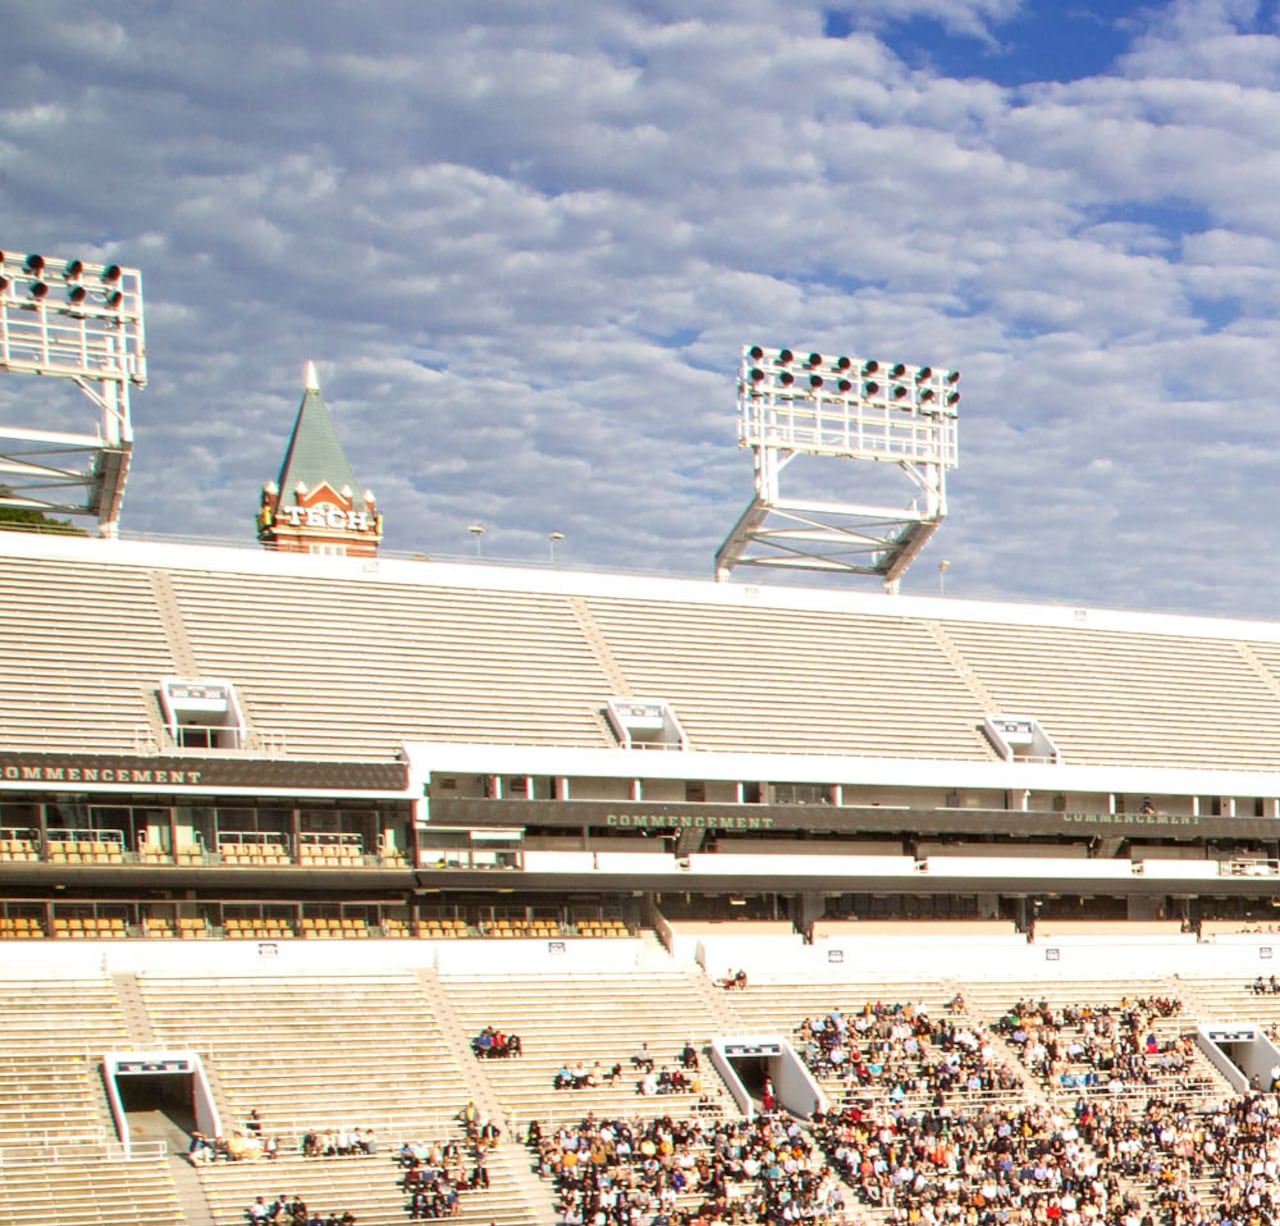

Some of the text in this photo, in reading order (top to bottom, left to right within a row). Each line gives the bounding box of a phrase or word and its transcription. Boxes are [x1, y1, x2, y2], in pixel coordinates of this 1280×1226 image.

[284, 506, 368, 530] TECH
[0, 766, 202, 783] OMMENCEMENT
[606, 814, 774, 829] COMMENCEMENT
